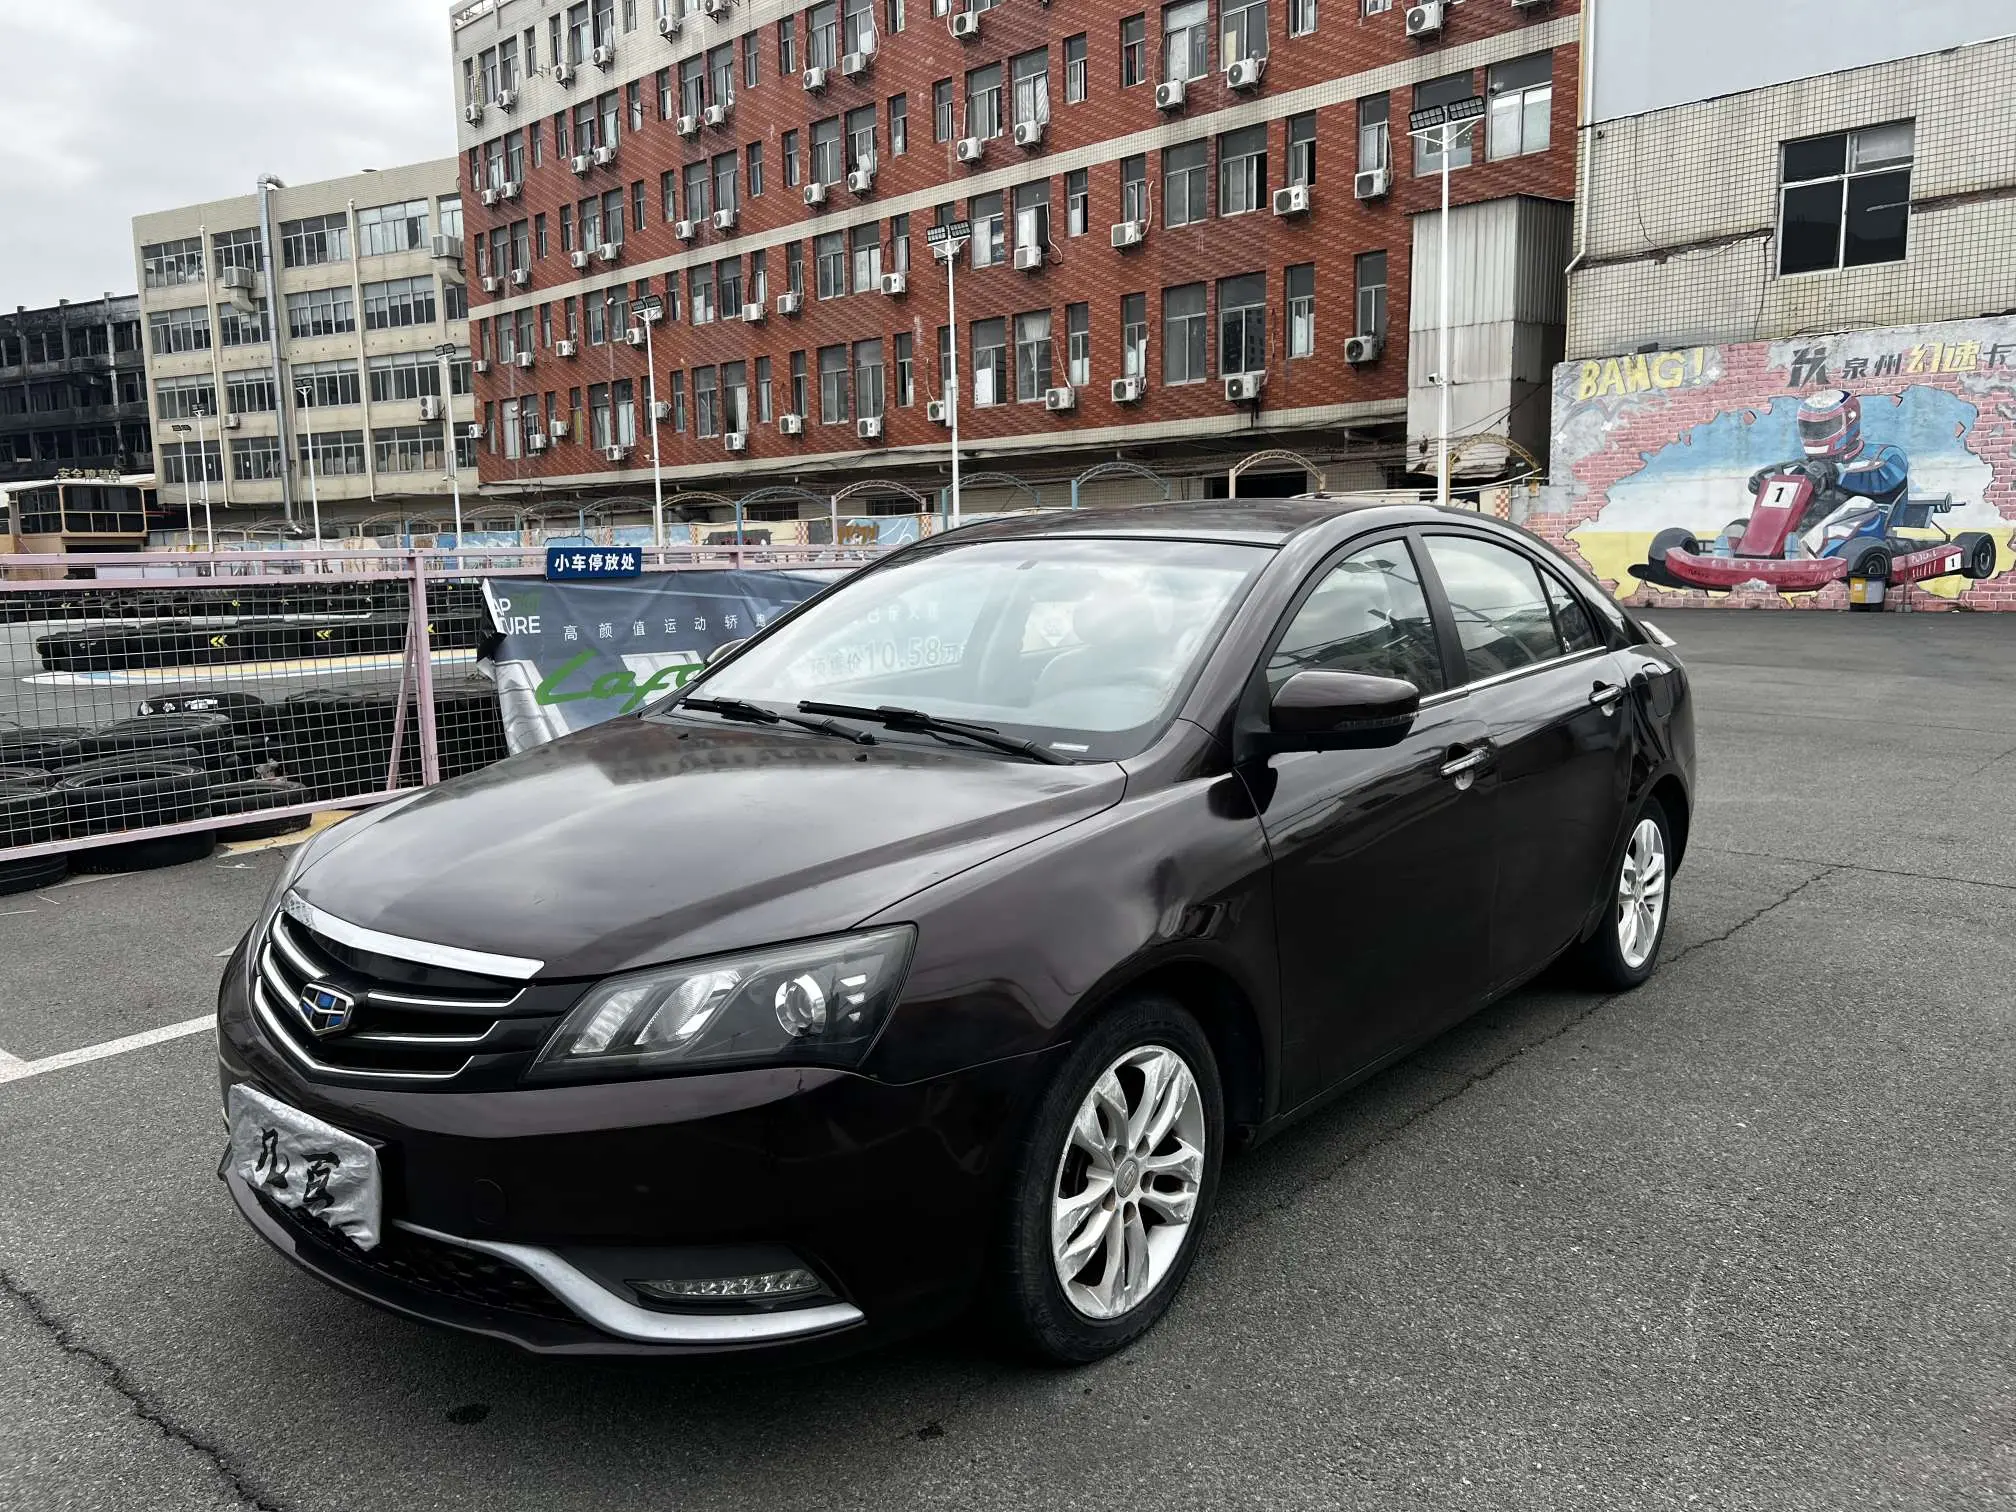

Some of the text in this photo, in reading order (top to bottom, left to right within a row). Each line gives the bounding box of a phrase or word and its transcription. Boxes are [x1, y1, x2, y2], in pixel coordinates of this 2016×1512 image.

[1775, 487, 1785, 503] 1
[554, 552, 635, 573] 小车停放处
[563, 612, 766, 642] 高颜值运动轿跑
